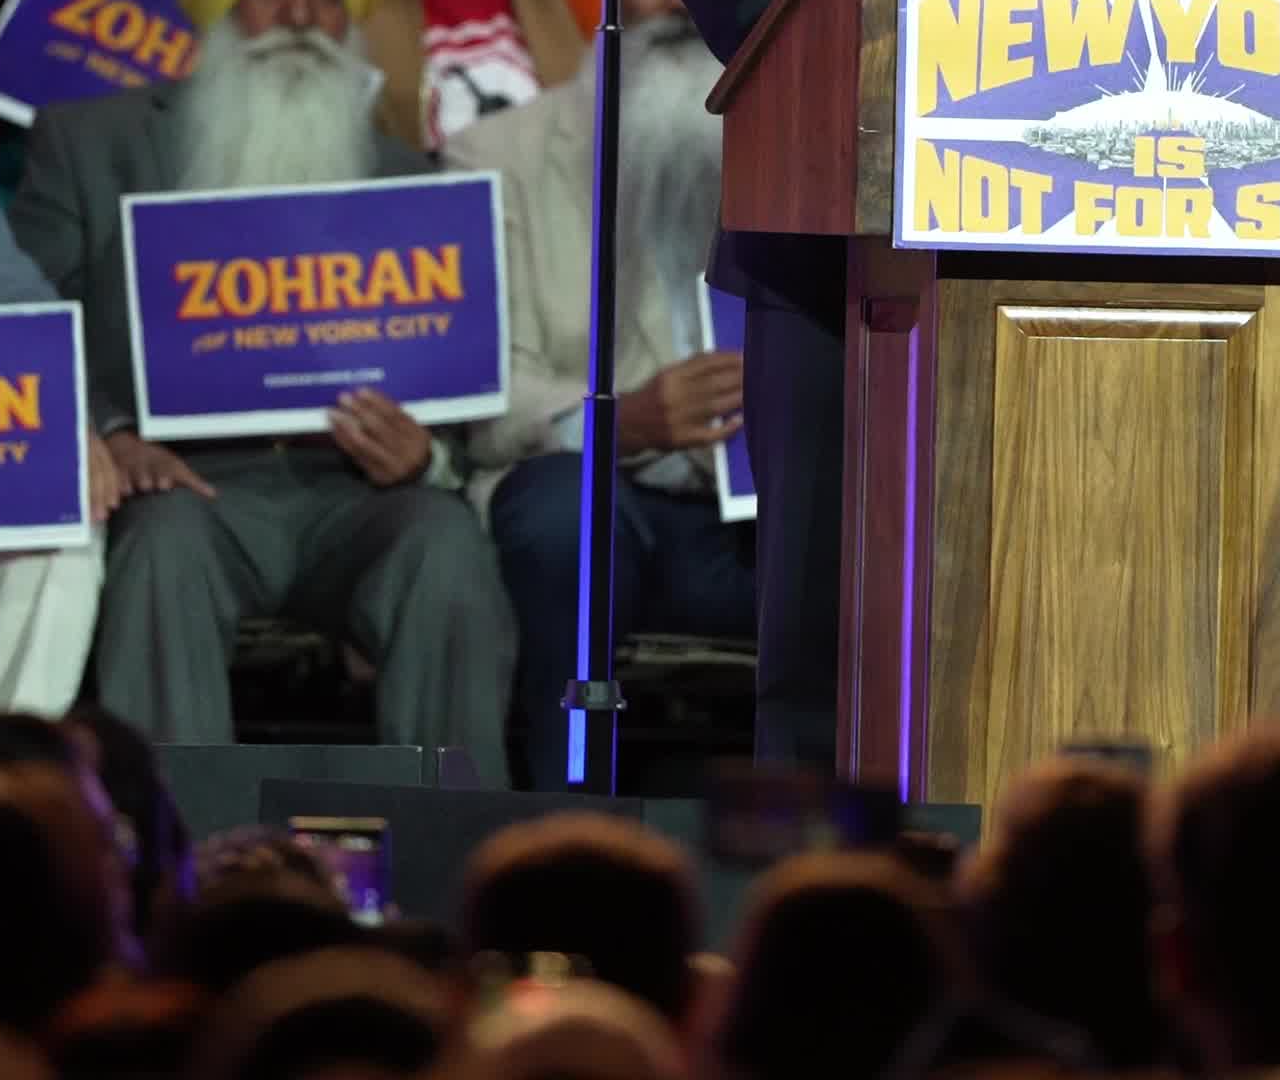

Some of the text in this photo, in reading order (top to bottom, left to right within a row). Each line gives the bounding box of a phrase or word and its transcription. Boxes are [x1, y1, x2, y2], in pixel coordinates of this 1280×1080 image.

[1133, 135, 1205, 179] IS
[913, 137, 1054, 233] NOT
[1073, 179, 1214, 239] FOR
[174, 243, 465, 320] ZOHRAN
[234, 324, 299, 351] NEW
[304, 319, 380, 345] YORK
[385, 313, 453, 338] CITY
